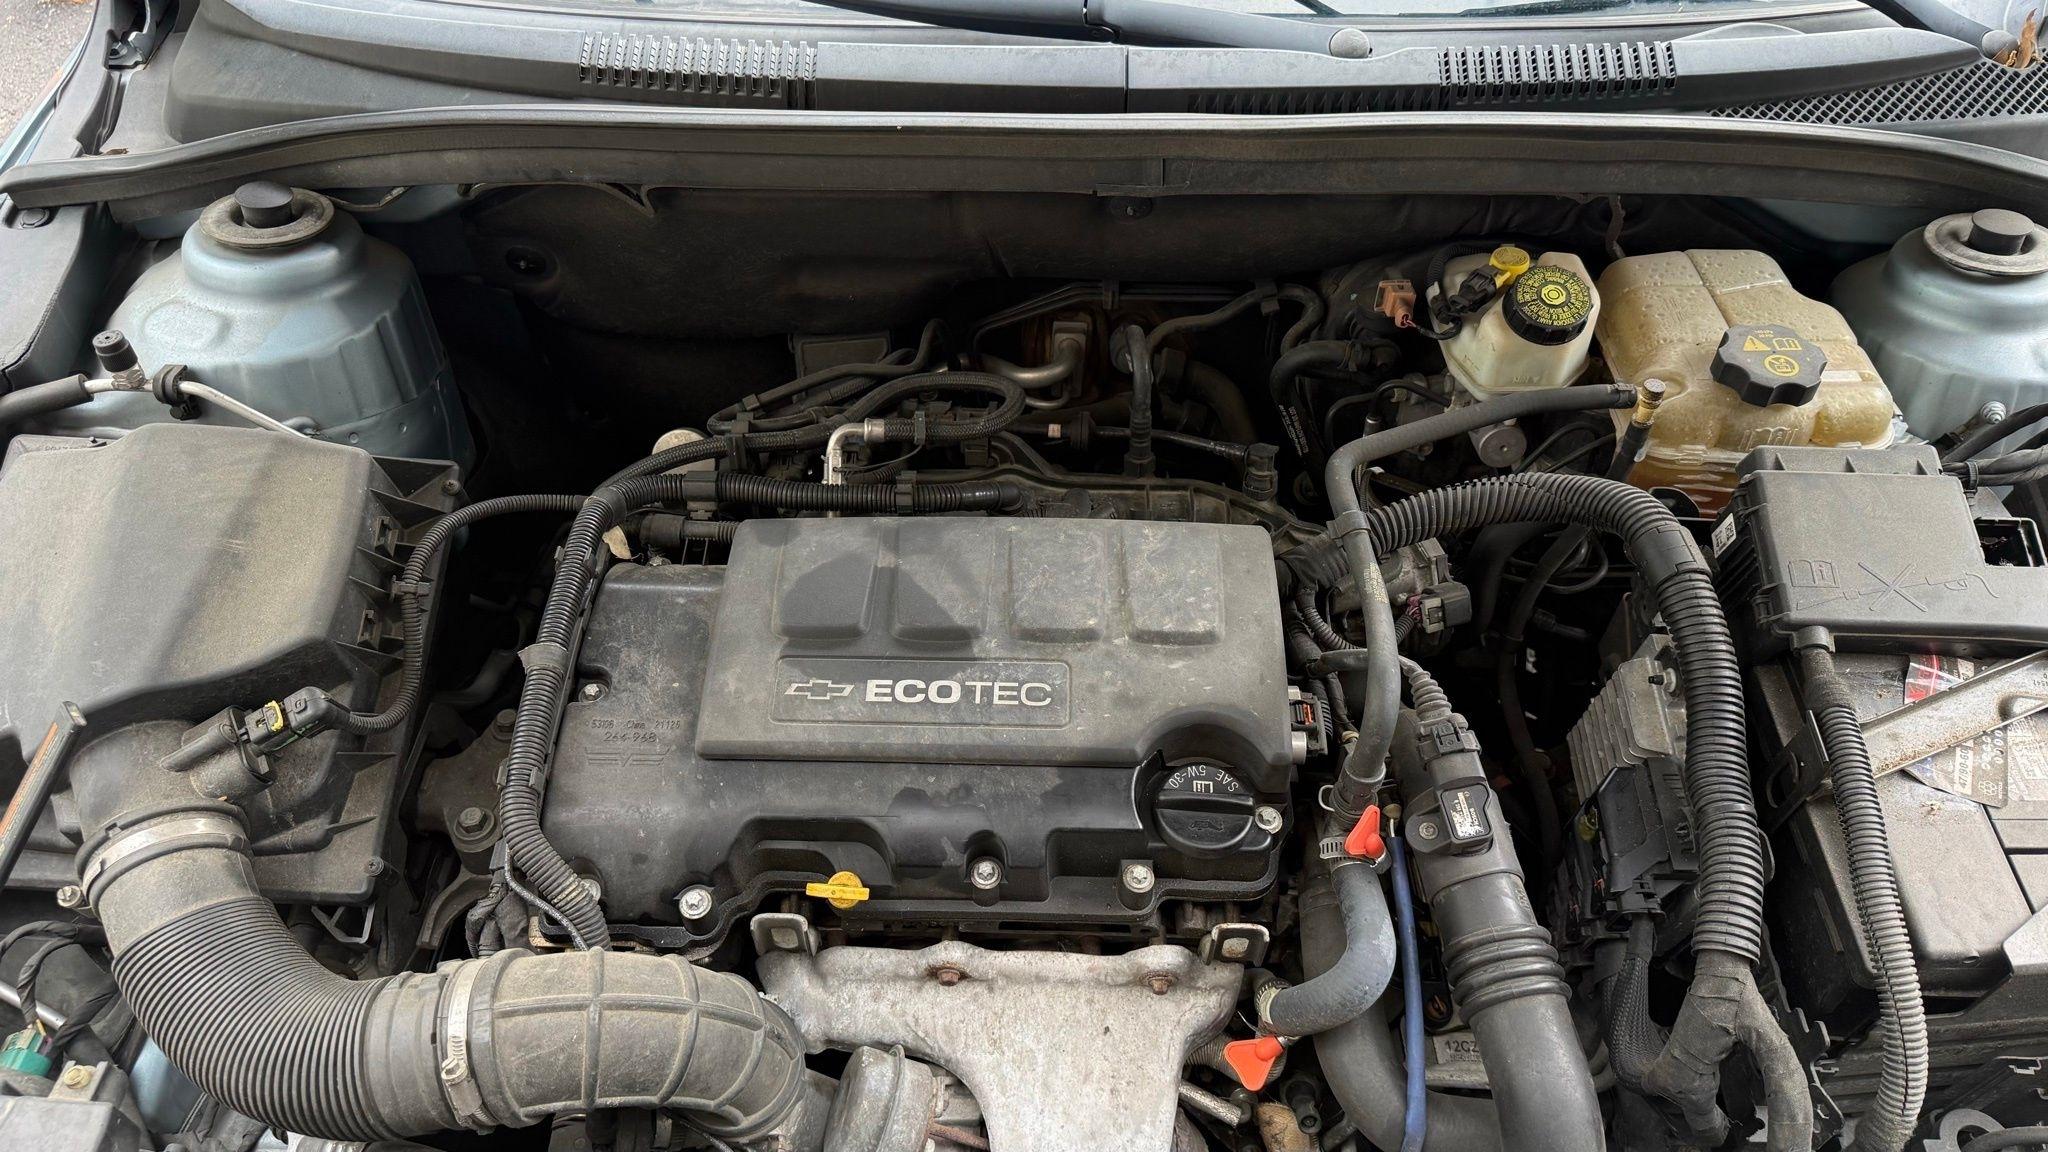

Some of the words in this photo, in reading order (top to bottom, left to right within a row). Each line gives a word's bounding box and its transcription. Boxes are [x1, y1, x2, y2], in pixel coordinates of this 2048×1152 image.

[865, 679, 1052, 706] ECOTEC
[1168, 764, 1207, 789] 5W-30
[1214, 769, 1239, 792] SAE
